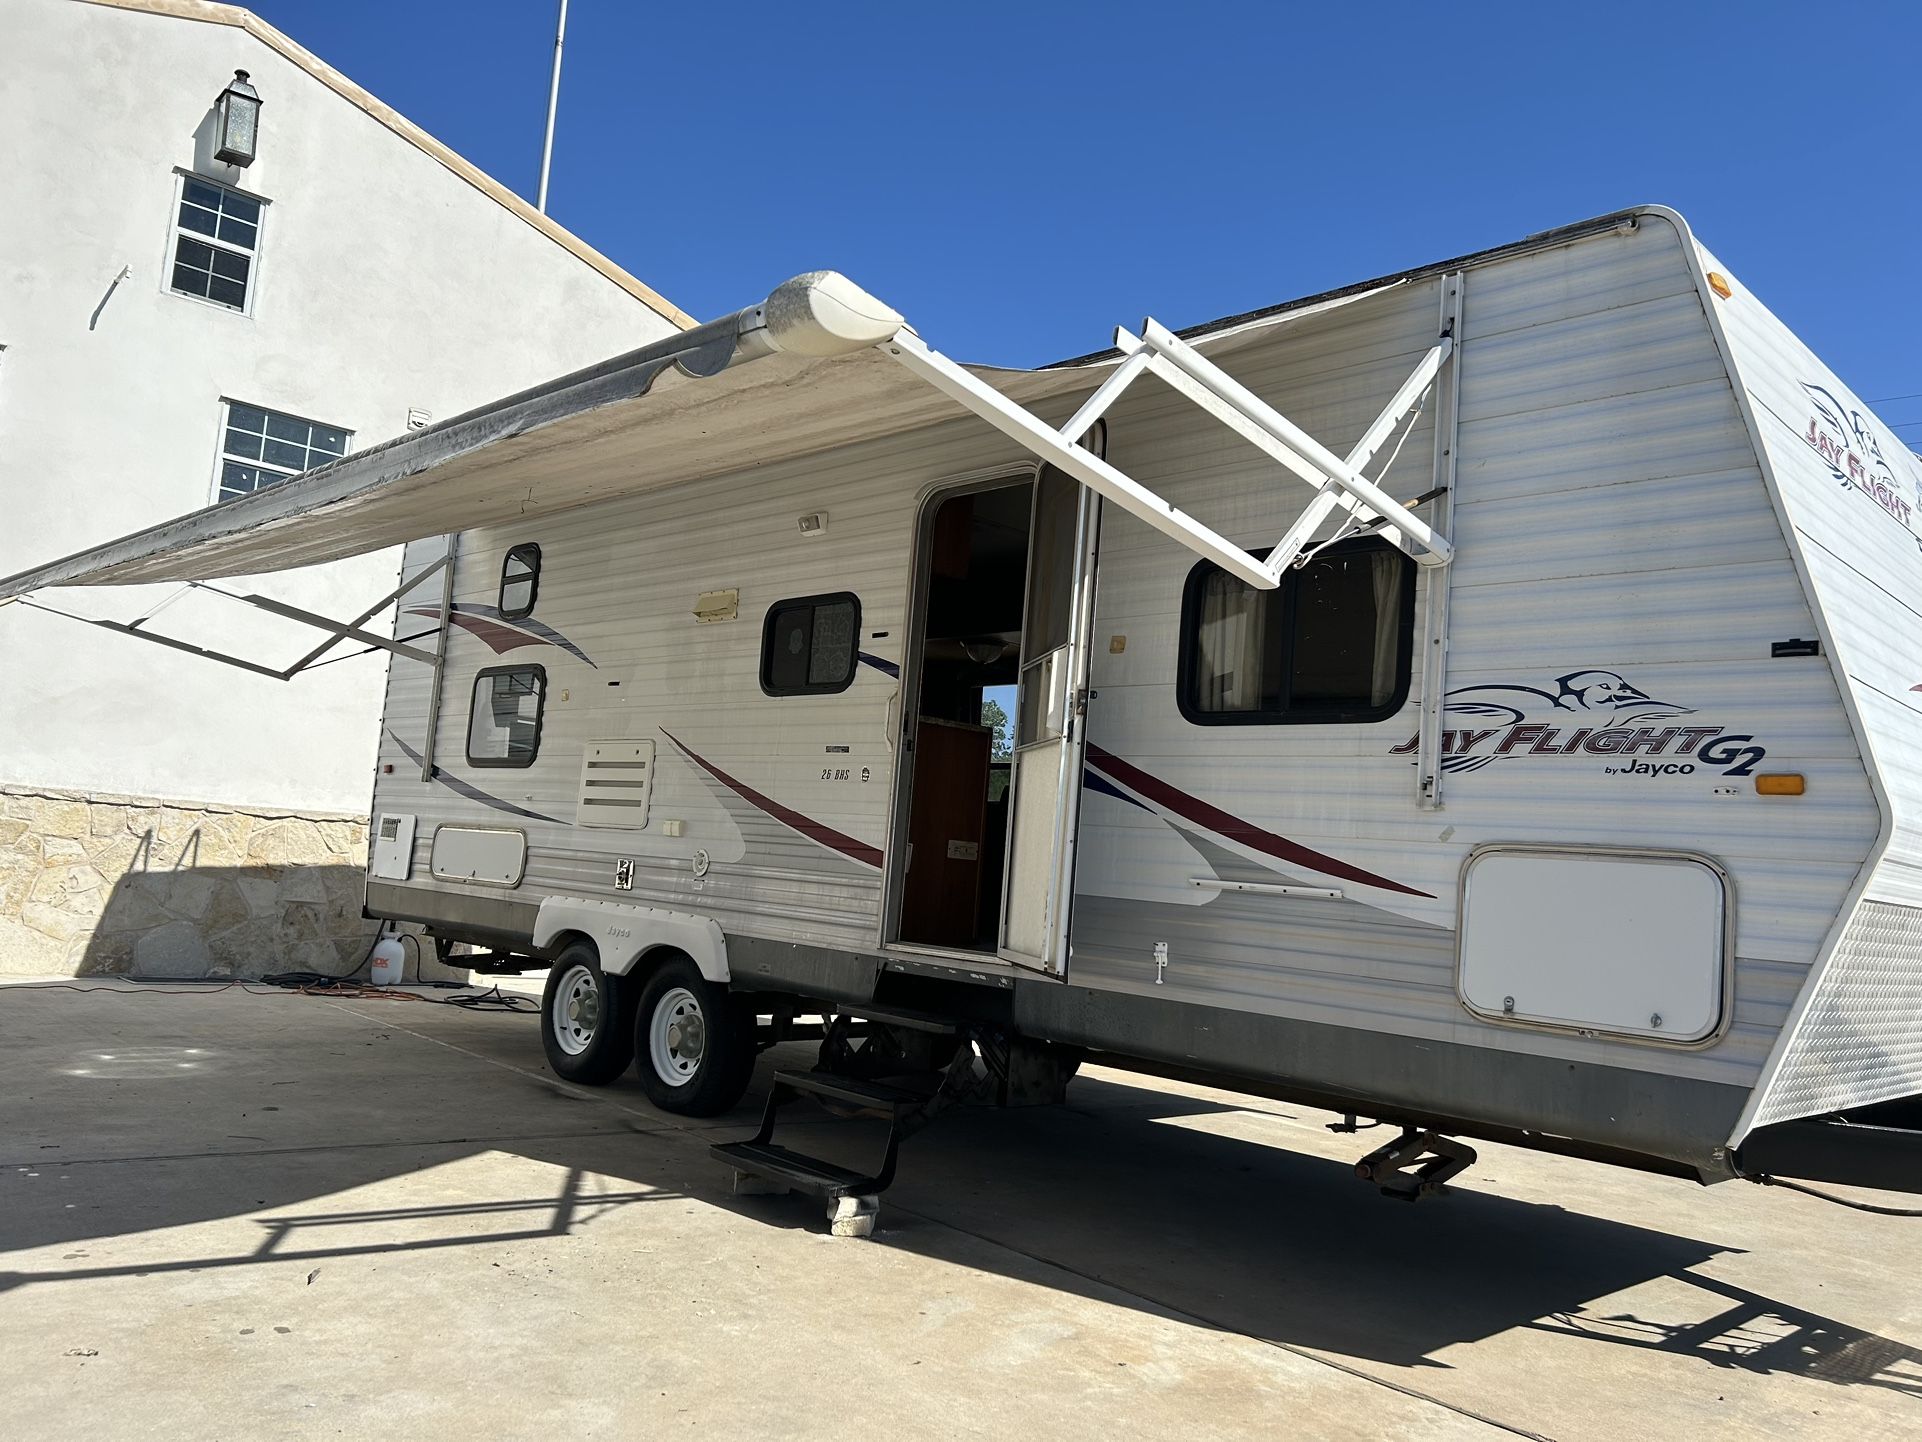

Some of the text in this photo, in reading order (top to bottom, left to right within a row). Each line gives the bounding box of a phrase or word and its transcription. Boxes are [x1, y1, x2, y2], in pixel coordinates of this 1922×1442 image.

[1805, 416, 1911, 526] JAY FLIGHT
[1493, 723, 1725, 755] FLIGHT
[1697, 734, 1766, 777] G2
[821, 769, 832, 780] 26
[834, 769, 850, 780] BHS
[1604, 759, 1695, 778] by Jayco
